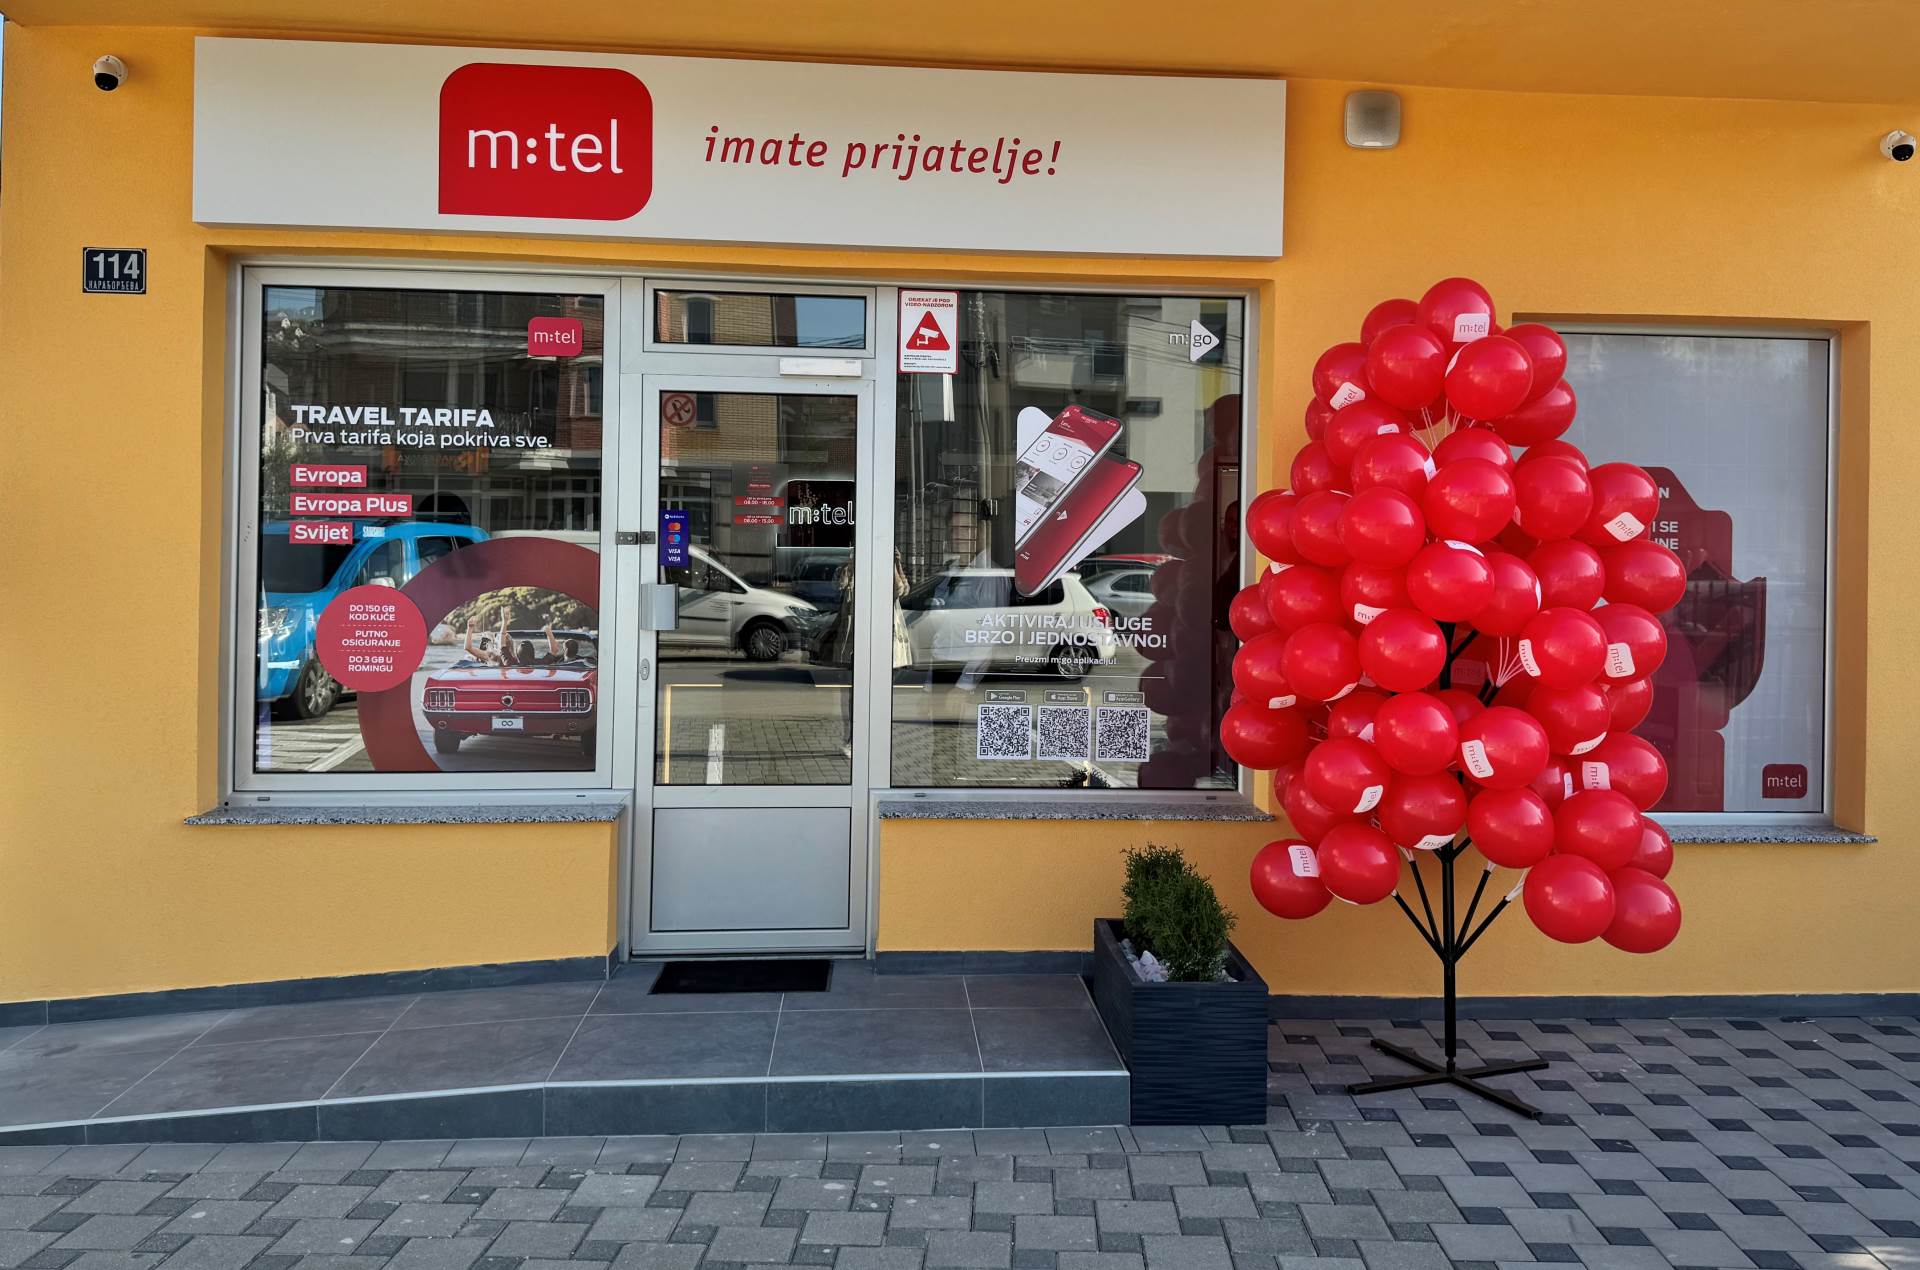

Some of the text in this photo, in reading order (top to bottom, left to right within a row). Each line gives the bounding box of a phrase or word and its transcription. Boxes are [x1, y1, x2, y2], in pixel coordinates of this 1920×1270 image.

[467, 118, 624, 175] m:tel
[703, 126, 1062, 184] imate prijatelje!
[92, 252, 140, 279] 114
[1459, 321, 1486, 333] m:tel
[534, 329, 576, 344] m:tel
[291, 404, 495, 428] TRAVEL TARIFA
[291, 428, 552, 449] Prva tarifa koja pokriva sve.
[295, 467, 362, 485] Evropa
[295, 496, 409, 514] Evropa Plus
[789, 500, 855, 525] m:tel
[294, 524, 349, 542] Svijet
[1660, 521, 1679, 533] SE
[349, 613, 370, 621] KOD
[981, 614, 1152, 631] AKTIVIRAJ USLUGE
[965, 630, 1167, 648] BRZO I JEDNOSTAVNO!
[348, 664, 393, 672] ROMINGU
[1015, 655, 1117, 666] Preuzmi m:go aplikaciju!
[1611, 648, 1627, 674] m:tel
[1468, 745, 1485, 774] m:tel
[1767, 774, 1802, 788] m:tel
[1296, 848, 1310, 873] m:tel
